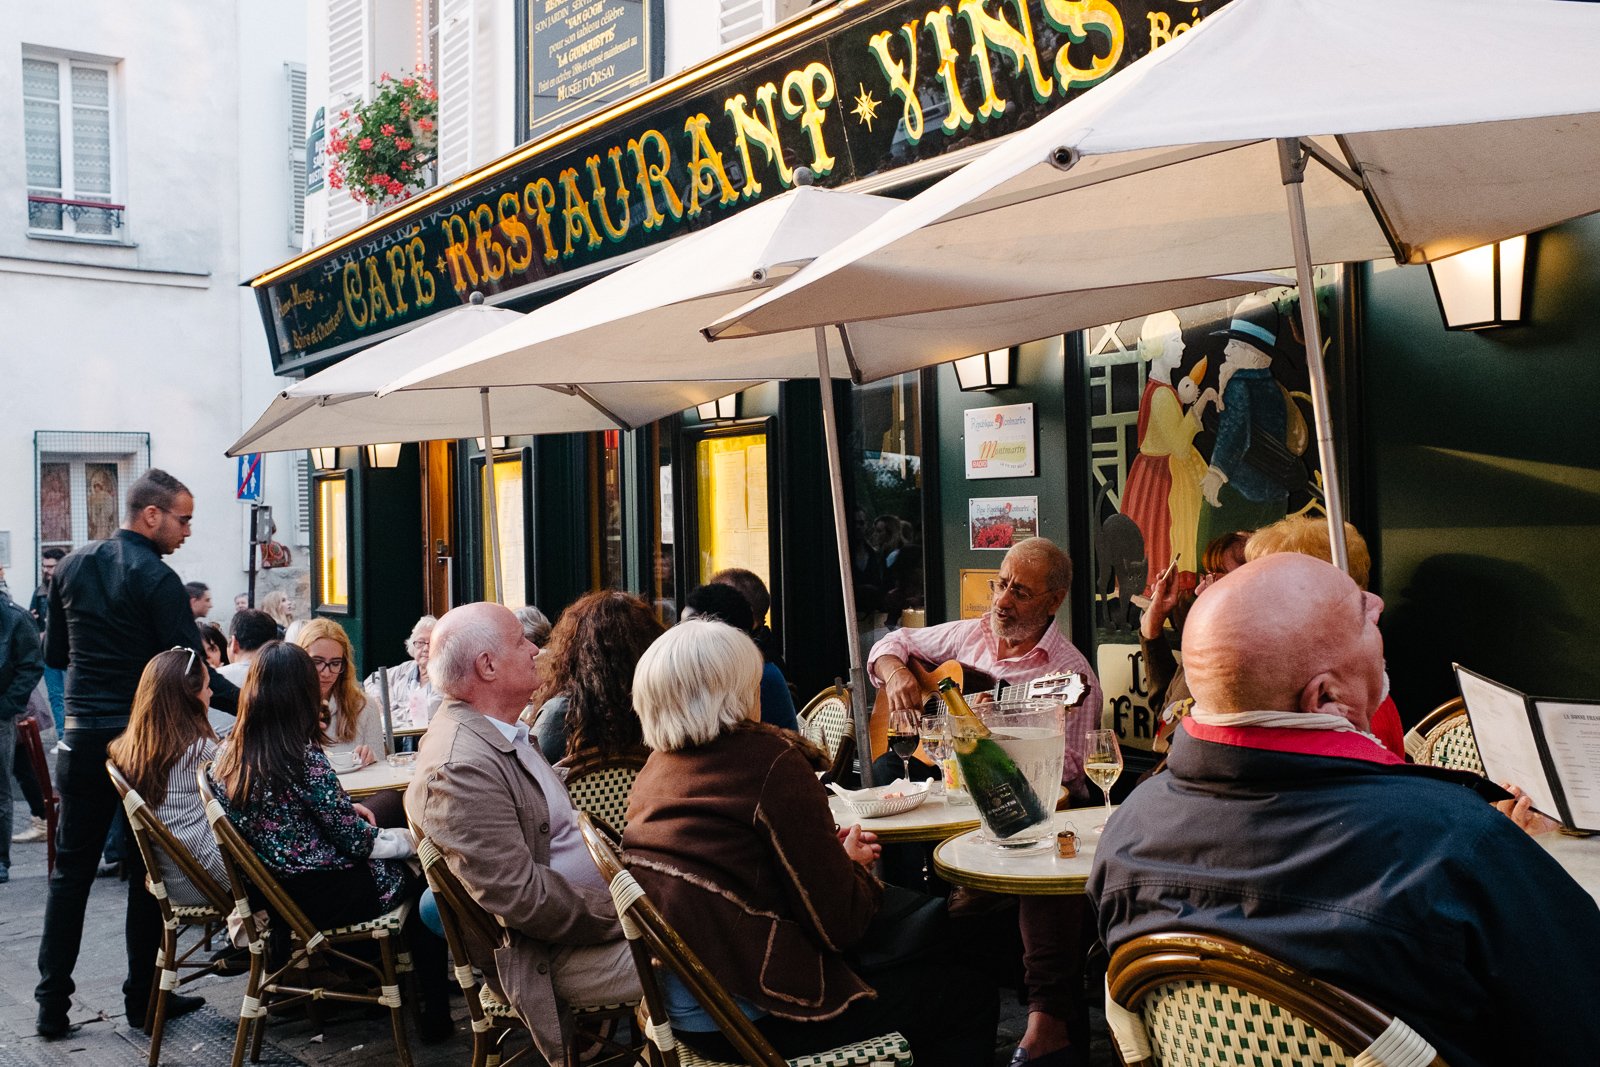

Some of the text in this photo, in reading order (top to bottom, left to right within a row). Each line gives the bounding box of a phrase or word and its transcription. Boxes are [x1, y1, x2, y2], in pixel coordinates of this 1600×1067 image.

[549, 39, 563, 58] pour
[564, 33, 576, 46] son
[576, 20, 600, 39] tableau
[343, 0, 1125, 331] CAFÉ RESTAURANT VINS
